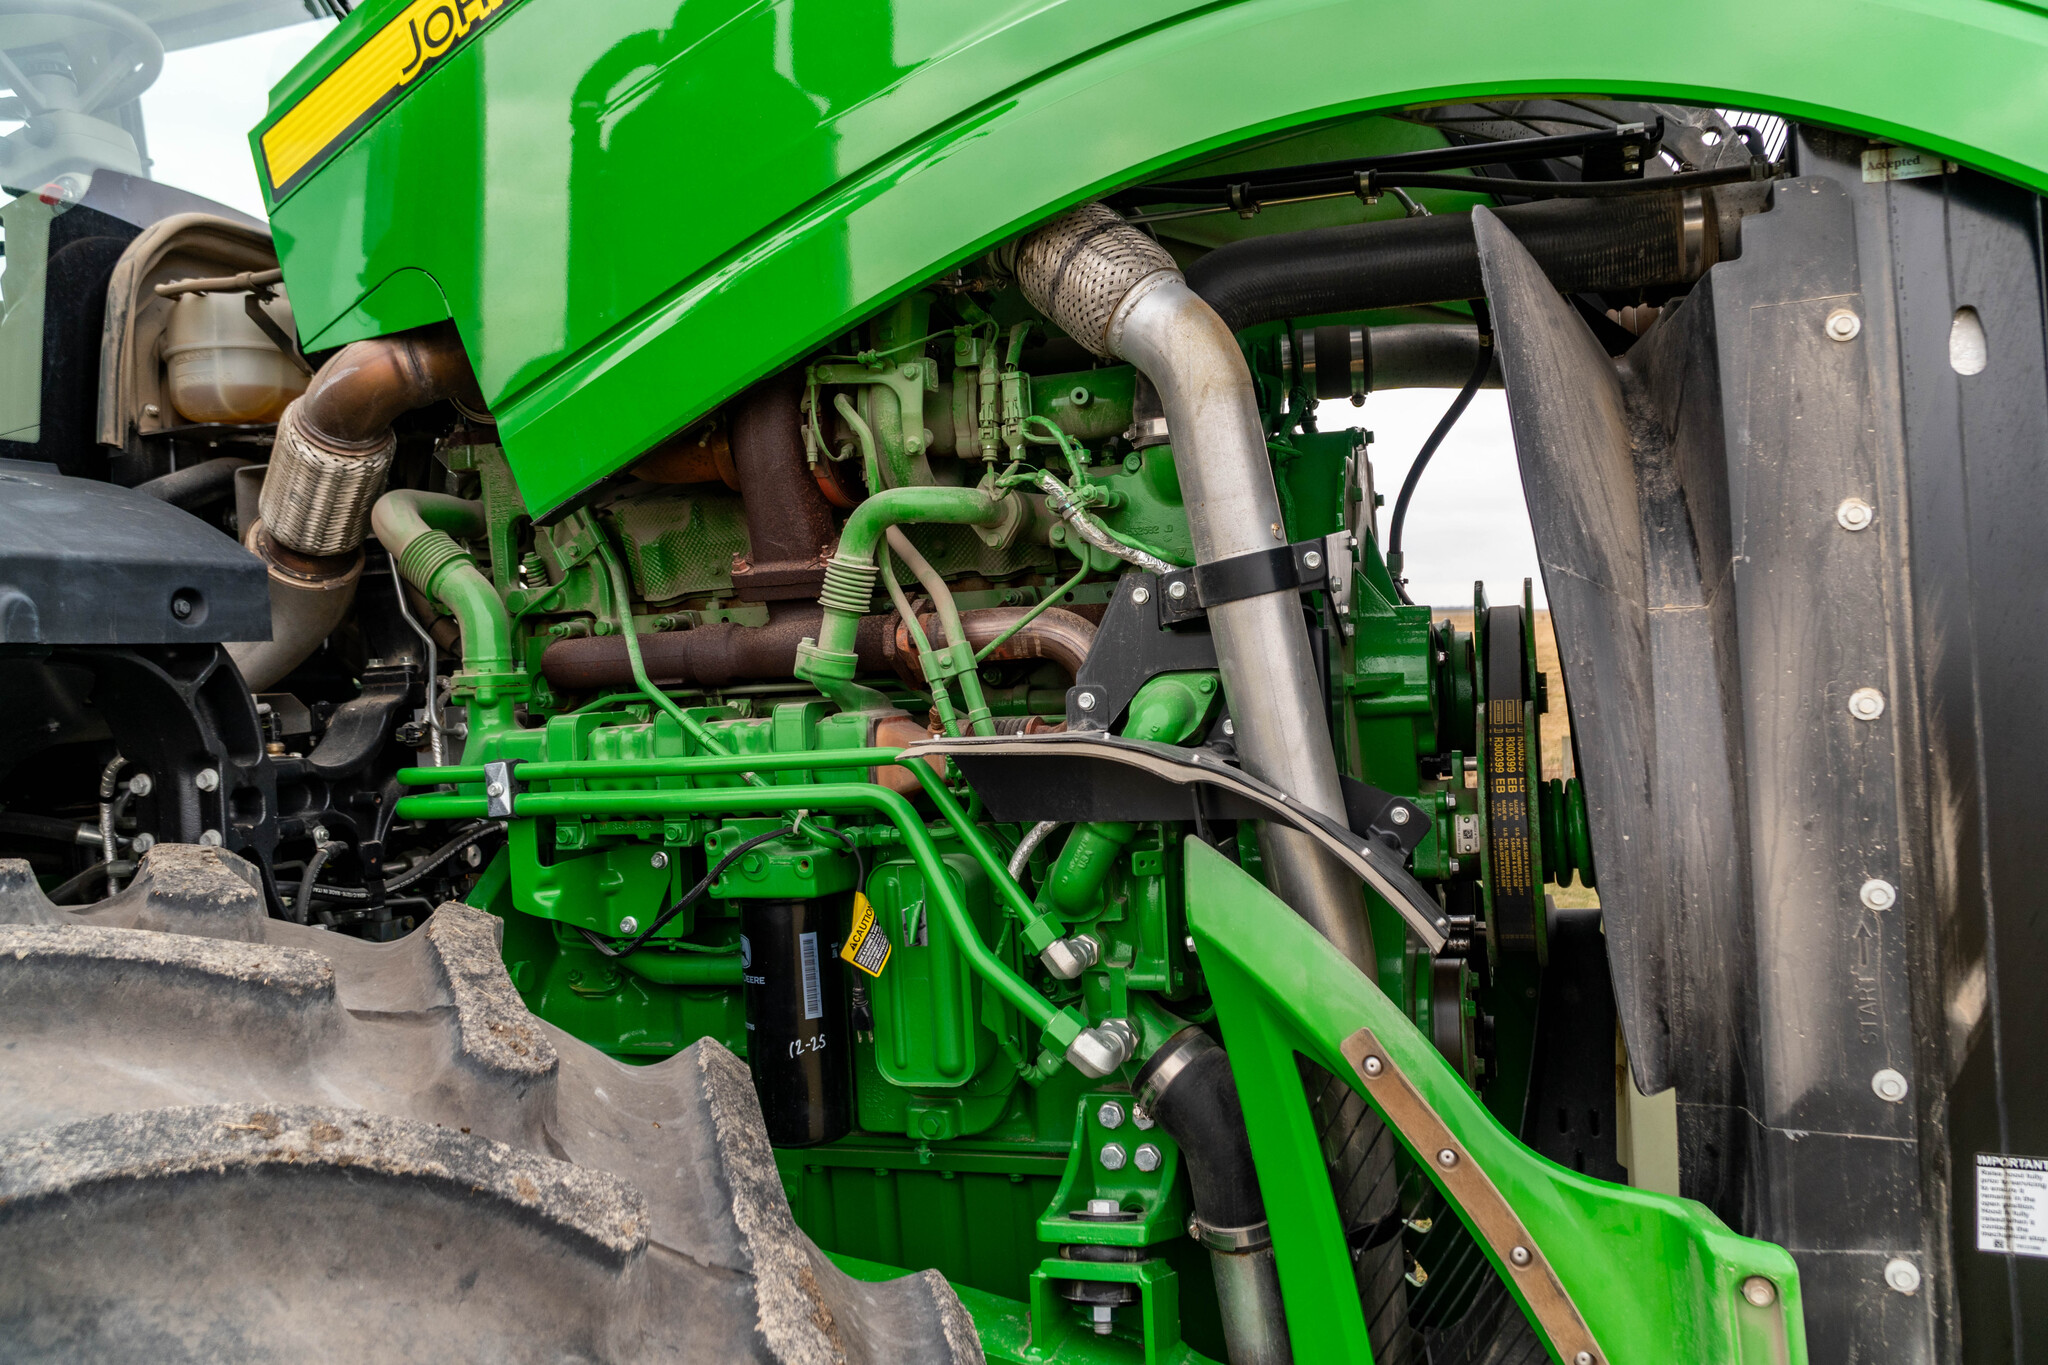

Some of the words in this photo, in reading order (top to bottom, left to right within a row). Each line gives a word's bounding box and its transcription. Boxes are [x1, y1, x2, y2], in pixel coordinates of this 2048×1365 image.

[402, 0, 490, 76] JOH
[1867, 155, 1921, 171] Accepted
[1493, 736, 1505, 774] R300399
[1505, 736, 1517, 773] R300399
[1495, 778, 1506, 794] EB
[1507, 777, 1518, 793] EB
[1857, 971, 1878, 1045] START
